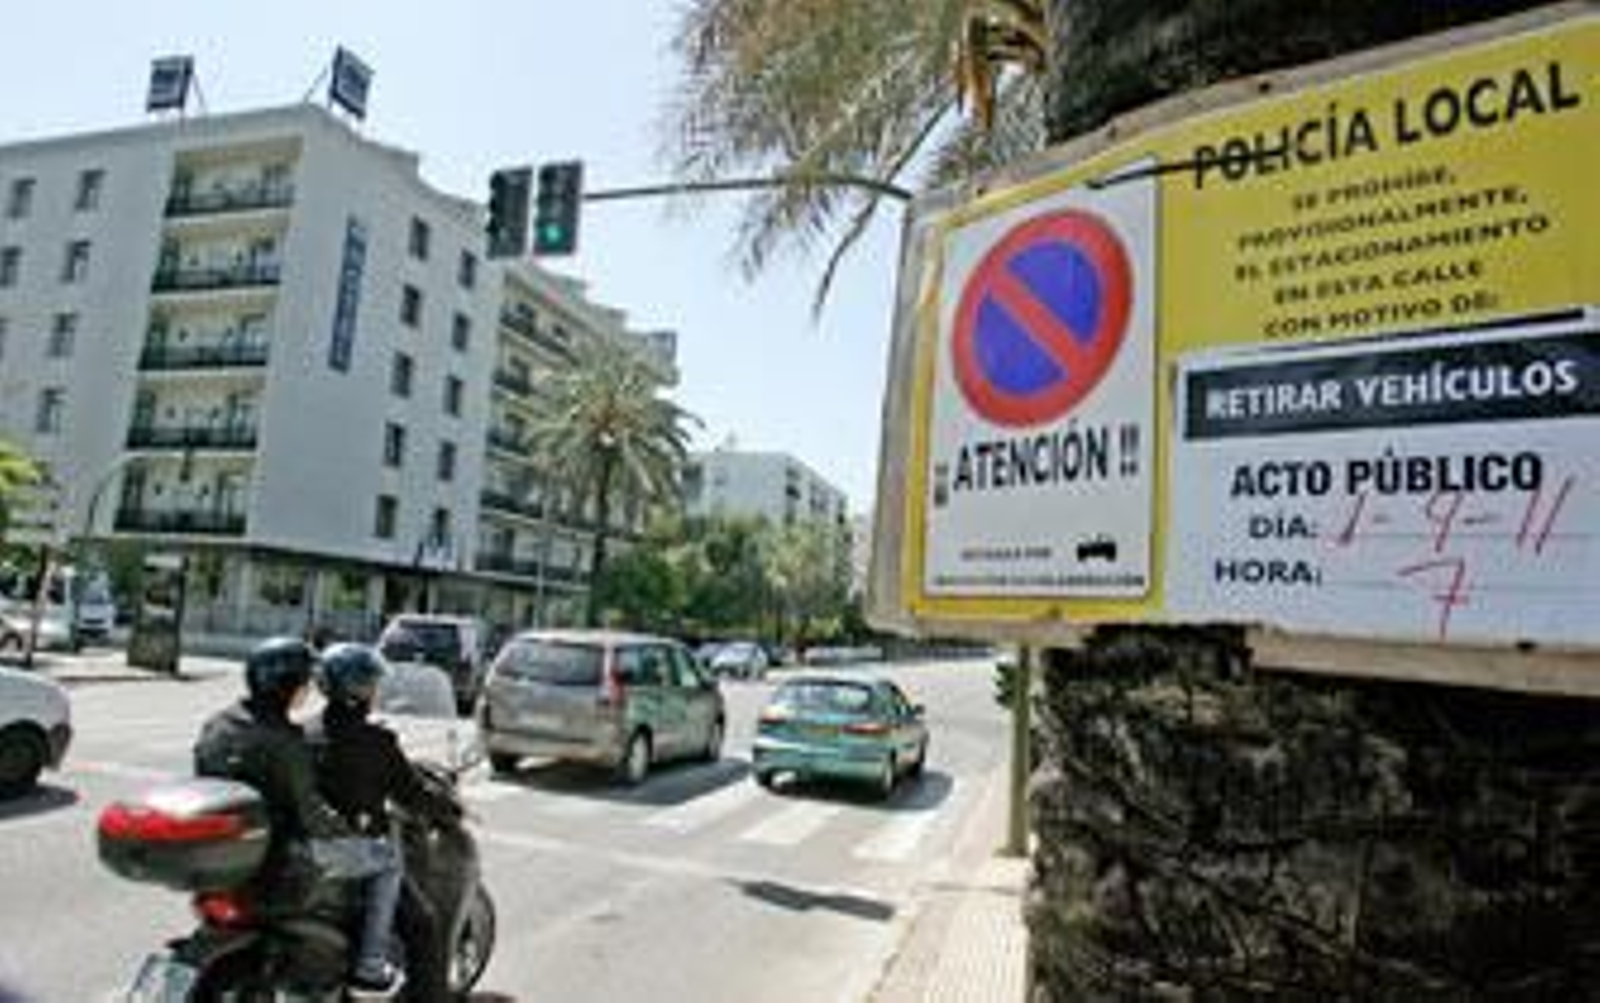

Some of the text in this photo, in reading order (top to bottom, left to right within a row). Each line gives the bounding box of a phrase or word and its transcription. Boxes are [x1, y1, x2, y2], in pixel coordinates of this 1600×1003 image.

[1192, 62, 1580, 189] POLICÍA LOCAL
[1269, 214, 1549, 277] ESTACIONAMIENTO
[1274, 259, 1483, 305] EN ESTA CALLE
[1264, 317, 1321, 338] CON
[1330, 298, 1442, 329] MOTIVO
[1206, 358, 1578, 419] RETIRAR VEHÍCULOS
[953, 418, 1108, 491] ATENCIÓN
[1230, 442, 1543, 498] ACTO PÚBLICO
[1214, 559, 1322, 587] HORA:
[1396, 557, 1470, 640] 7
